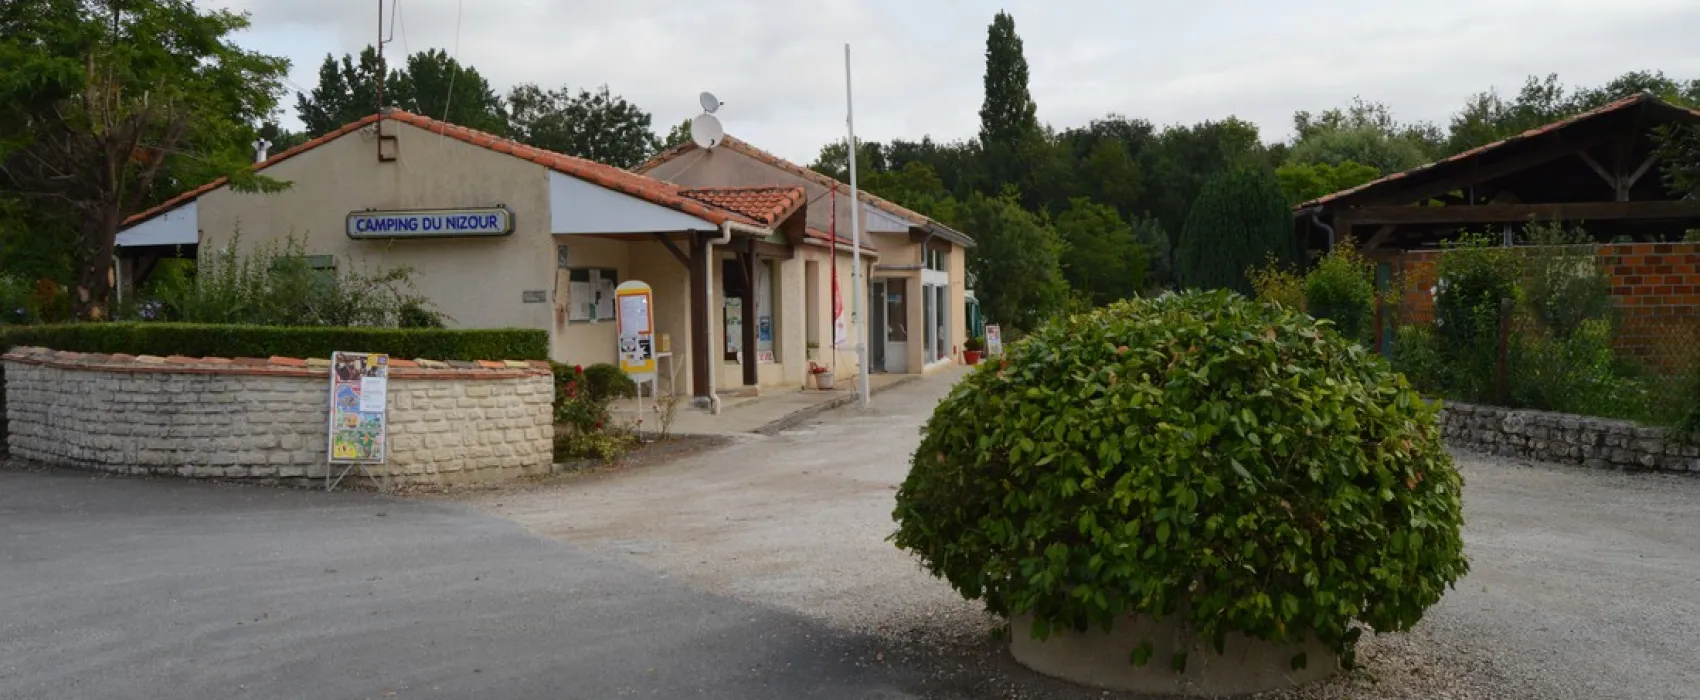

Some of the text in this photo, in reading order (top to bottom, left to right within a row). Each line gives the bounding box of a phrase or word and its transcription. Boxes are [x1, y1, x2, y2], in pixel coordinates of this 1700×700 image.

[356, 215, 498, 232] CAMPING DU NIZOUR
